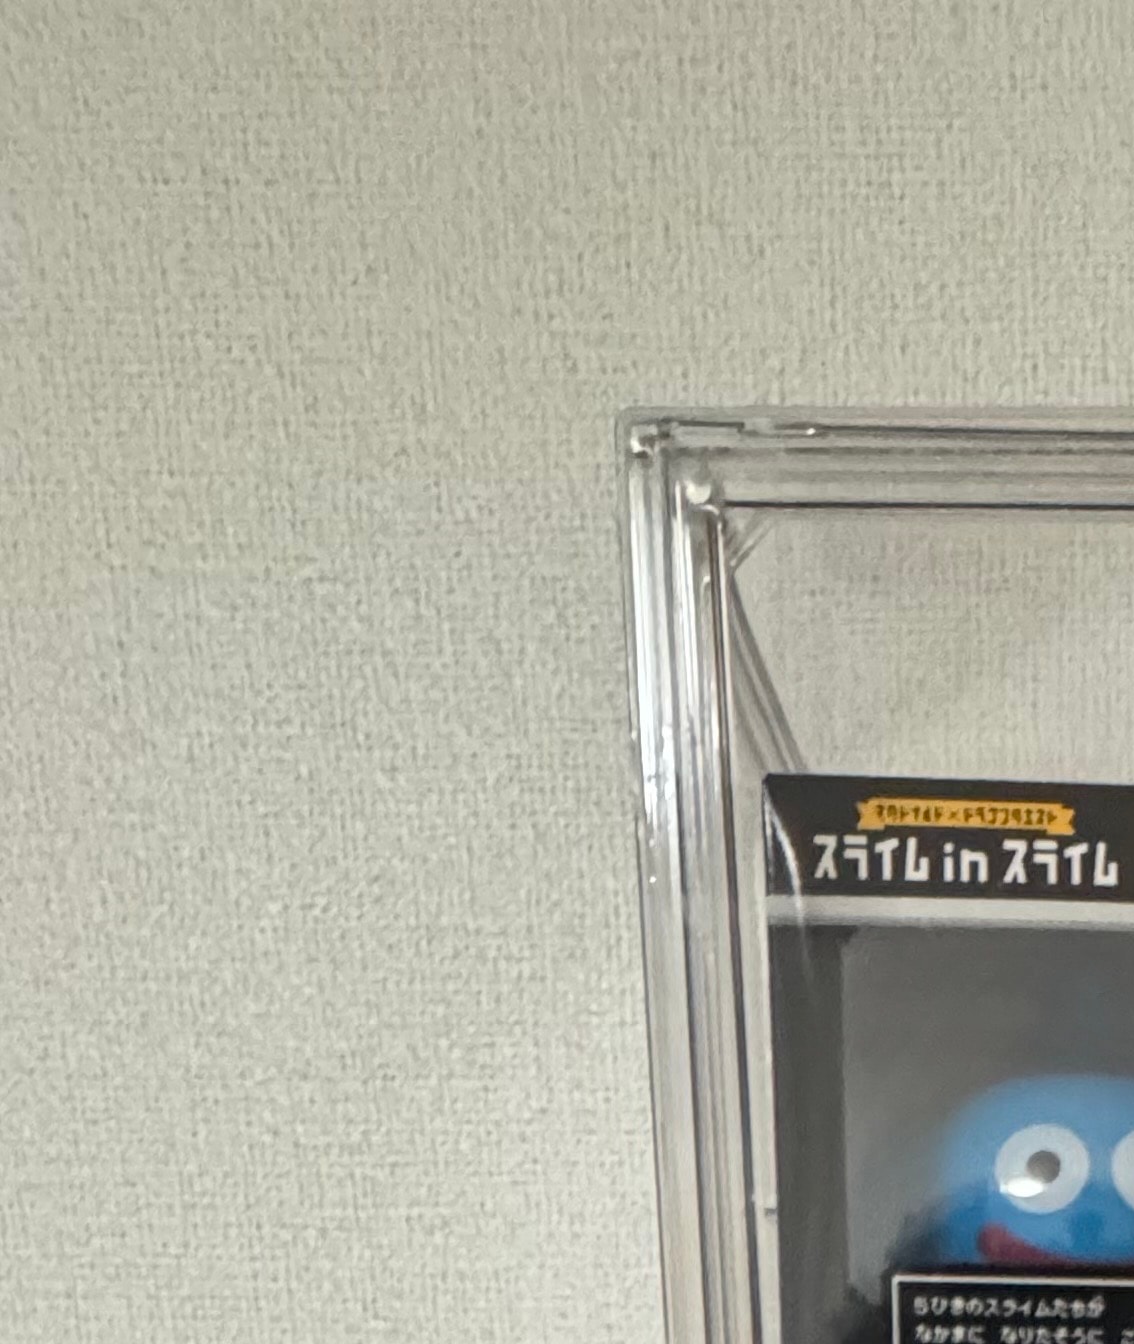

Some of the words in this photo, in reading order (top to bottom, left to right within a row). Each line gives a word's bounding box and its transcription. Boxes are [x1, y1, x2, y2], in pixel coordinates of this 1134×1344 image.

[812, 834, 931, 882] スライム
[942, 841, 989, 884] in
[1001, 838, 1119, 887] スライム
